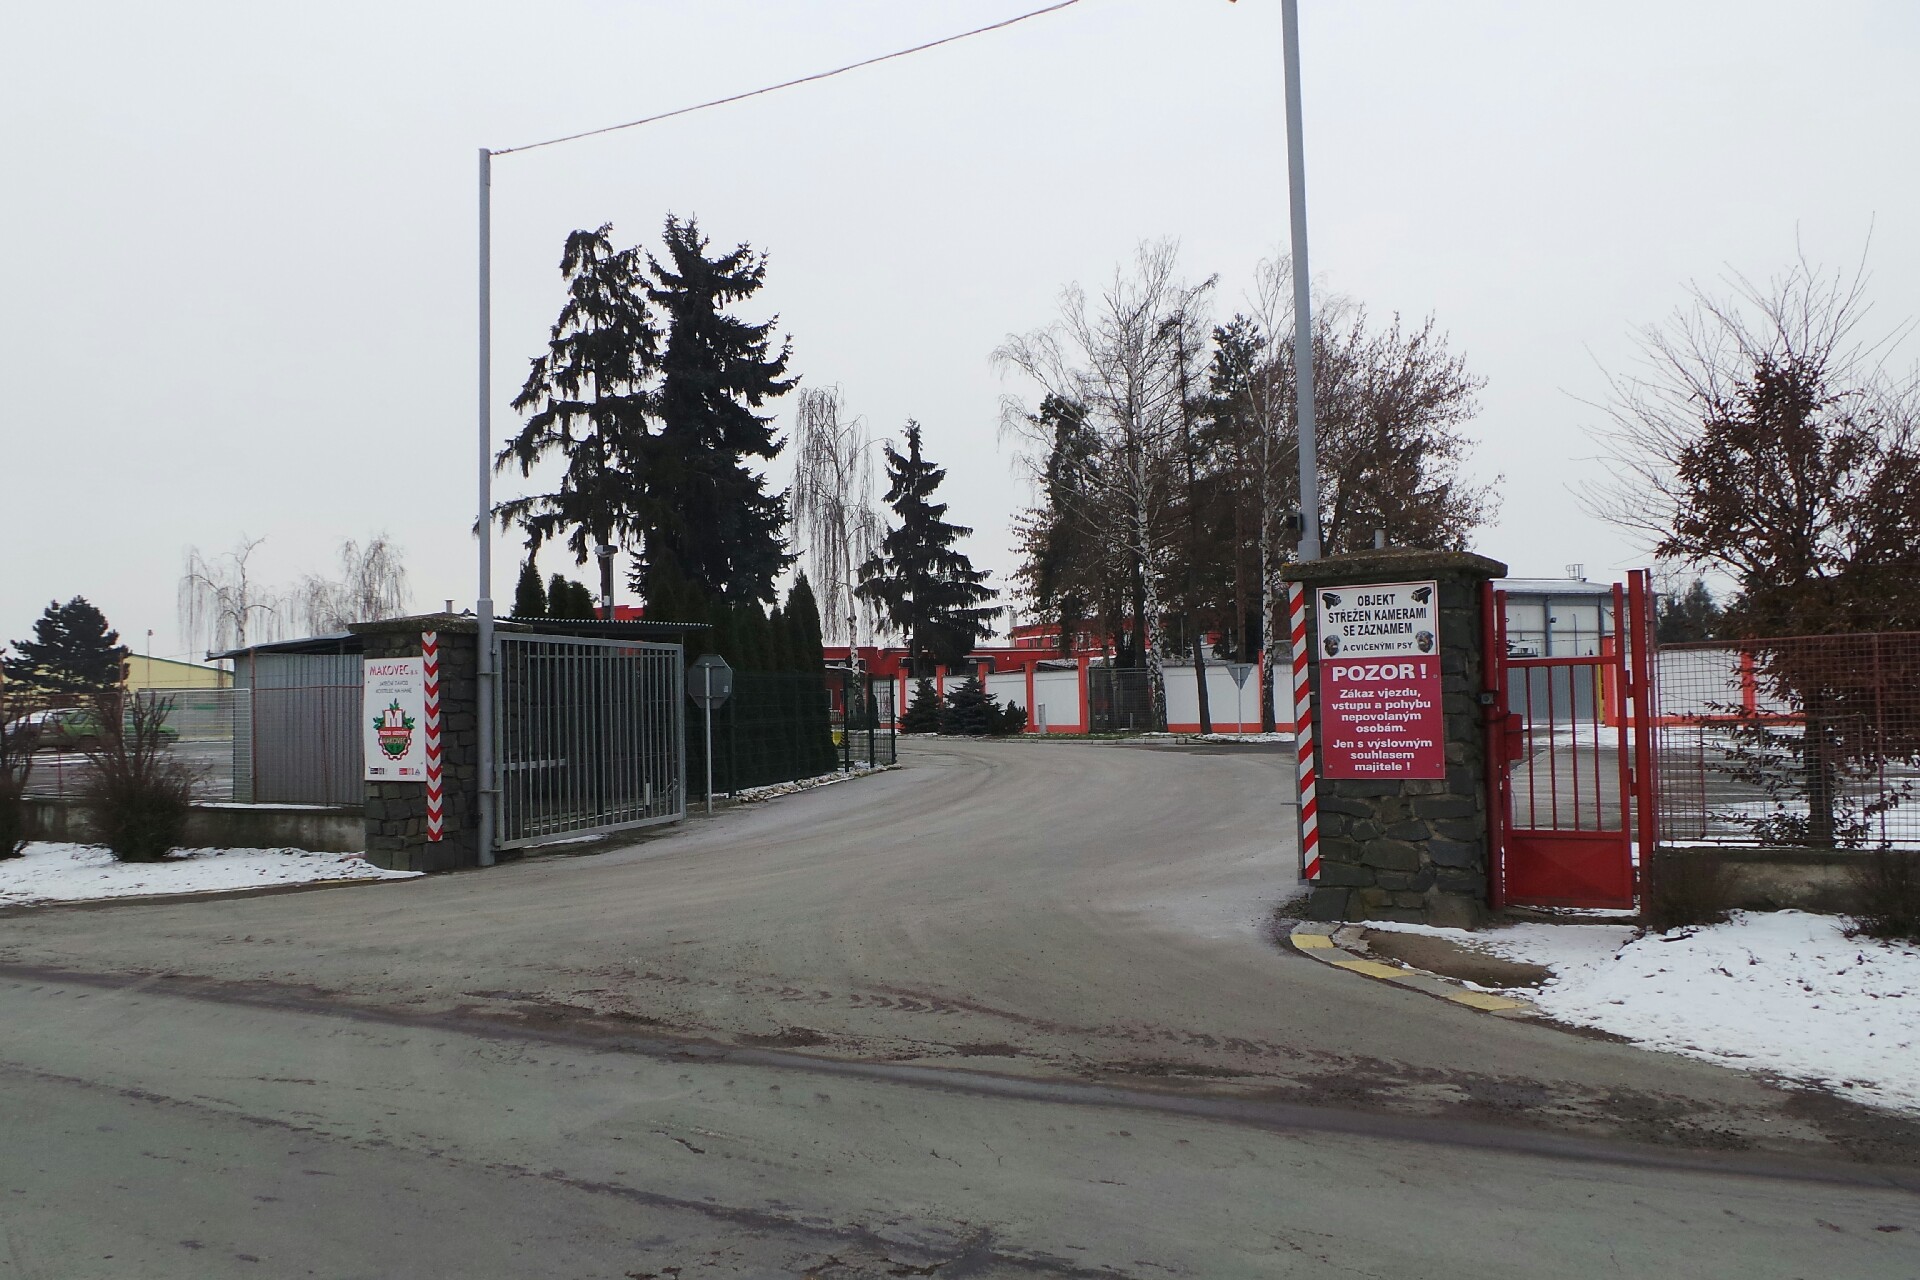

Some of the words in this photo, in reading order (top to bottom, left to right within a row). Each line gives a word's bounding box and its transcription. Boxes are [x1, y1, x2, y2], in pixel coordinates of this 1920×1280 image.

[1357, 594, 1395, 606] OBJEKT
[1328, 609, 1371, 623] STŘEŽEN
[1374, 608, 1426, 620] KAMERAMI
[1343, 625, 1355, 636] SE
[1358, 622, 1412, 635] ZÁZNAMEM
[1351, 642, 1394, 651] CVIČENÝMI
[1397, 642, 1413, 650] PSY
[370, 665, 409, 676] MAKOVEC
[1332, 664, 1415, 681] POZOR
[1340, 689, 1374, 698] Zákaz
[1378, 688, 1421, 699] vjezdu,
[1332, 702, 1371, 711] vstupu
[1385, 700, 1431, 710] pohybu
[1341, 711, 1421, 723] nepovolaným
[1356, 723, 1406, 733] osobám.
[1332, 740, 1354, 748] Jen
[1367, 738, 1432, 749] výslovným
[1350, 750, 1414, 759] souhlasem
[1354, 762, 1402, 773] majitele
